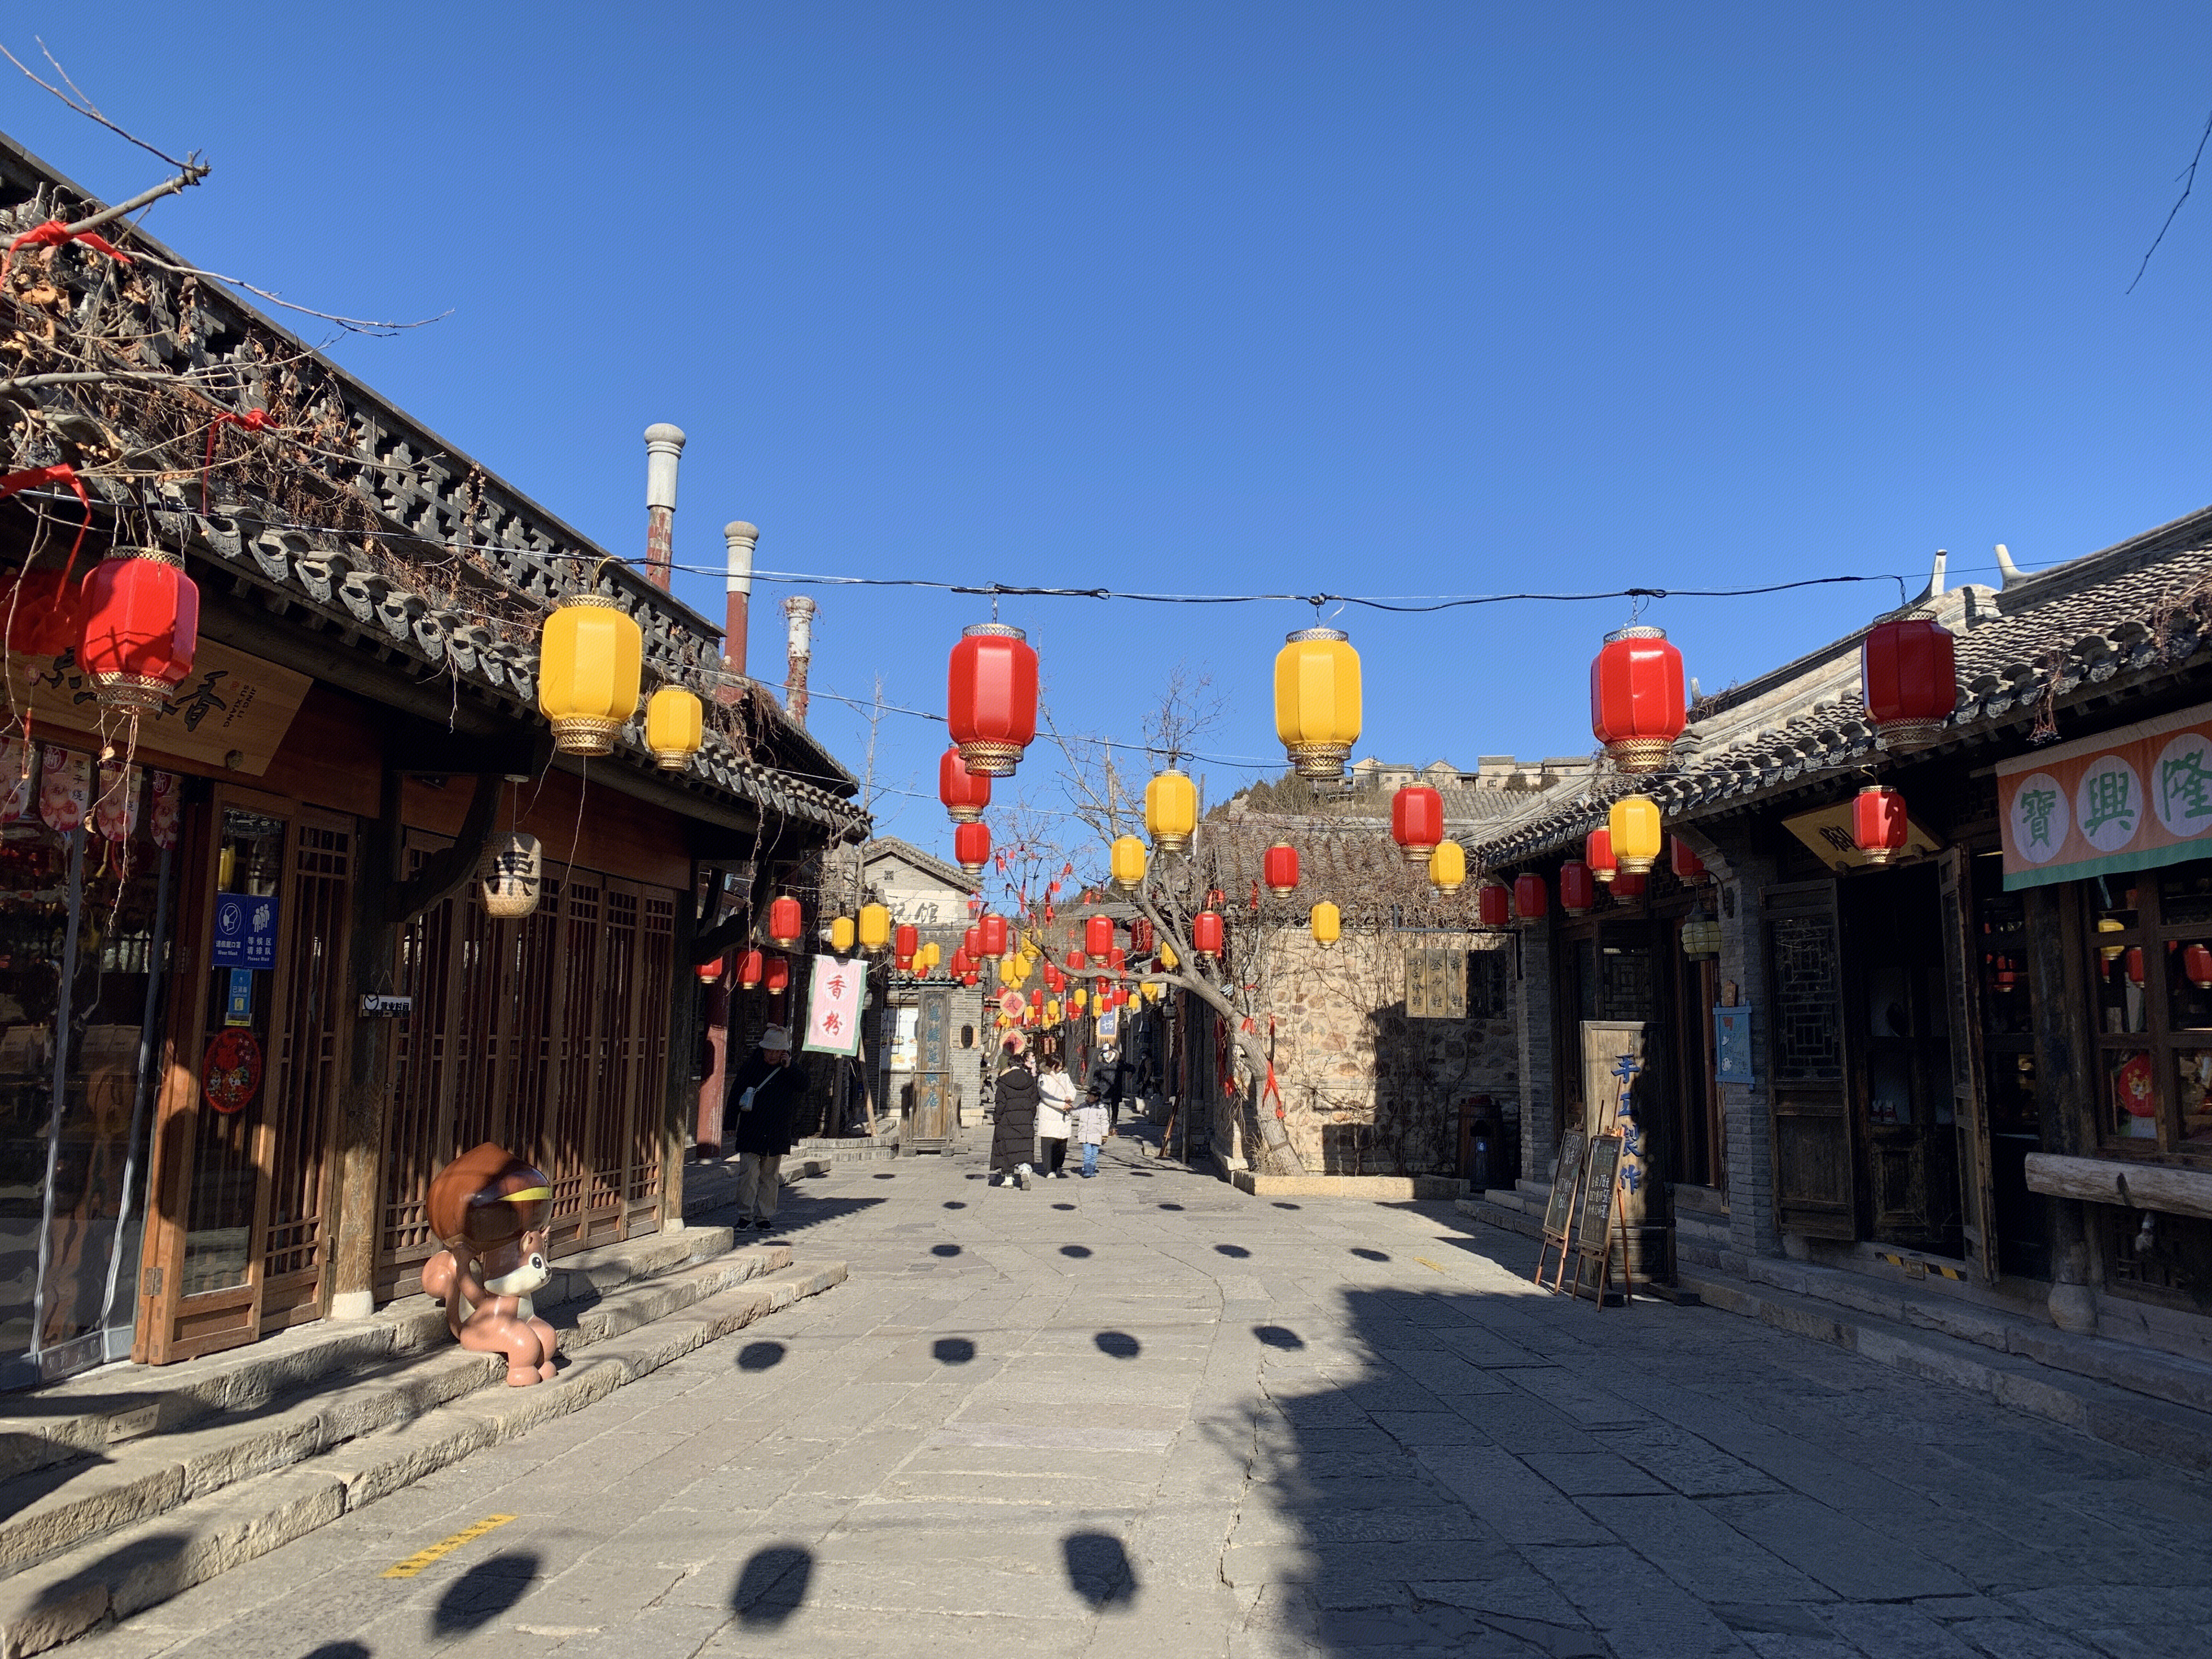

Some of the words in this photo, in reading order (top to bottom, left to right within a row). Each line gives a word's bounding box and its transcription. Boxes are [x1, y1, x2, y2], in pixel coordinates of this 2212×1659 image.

[240, 684, 250, 697] SU
[242, 687, 257, 708] JING
[222, 698, 242, 728] XIANG
[236, 710, 245, 719] LI
[2021, 748, 2212, 849] 寶興隆
[247, 936, 272, 946] 等候区
[247, 946, 271, 955] 请排队
[381, 1002, 409, 1011] 营业时间
[823, 974, 847, 1036] 香粉
